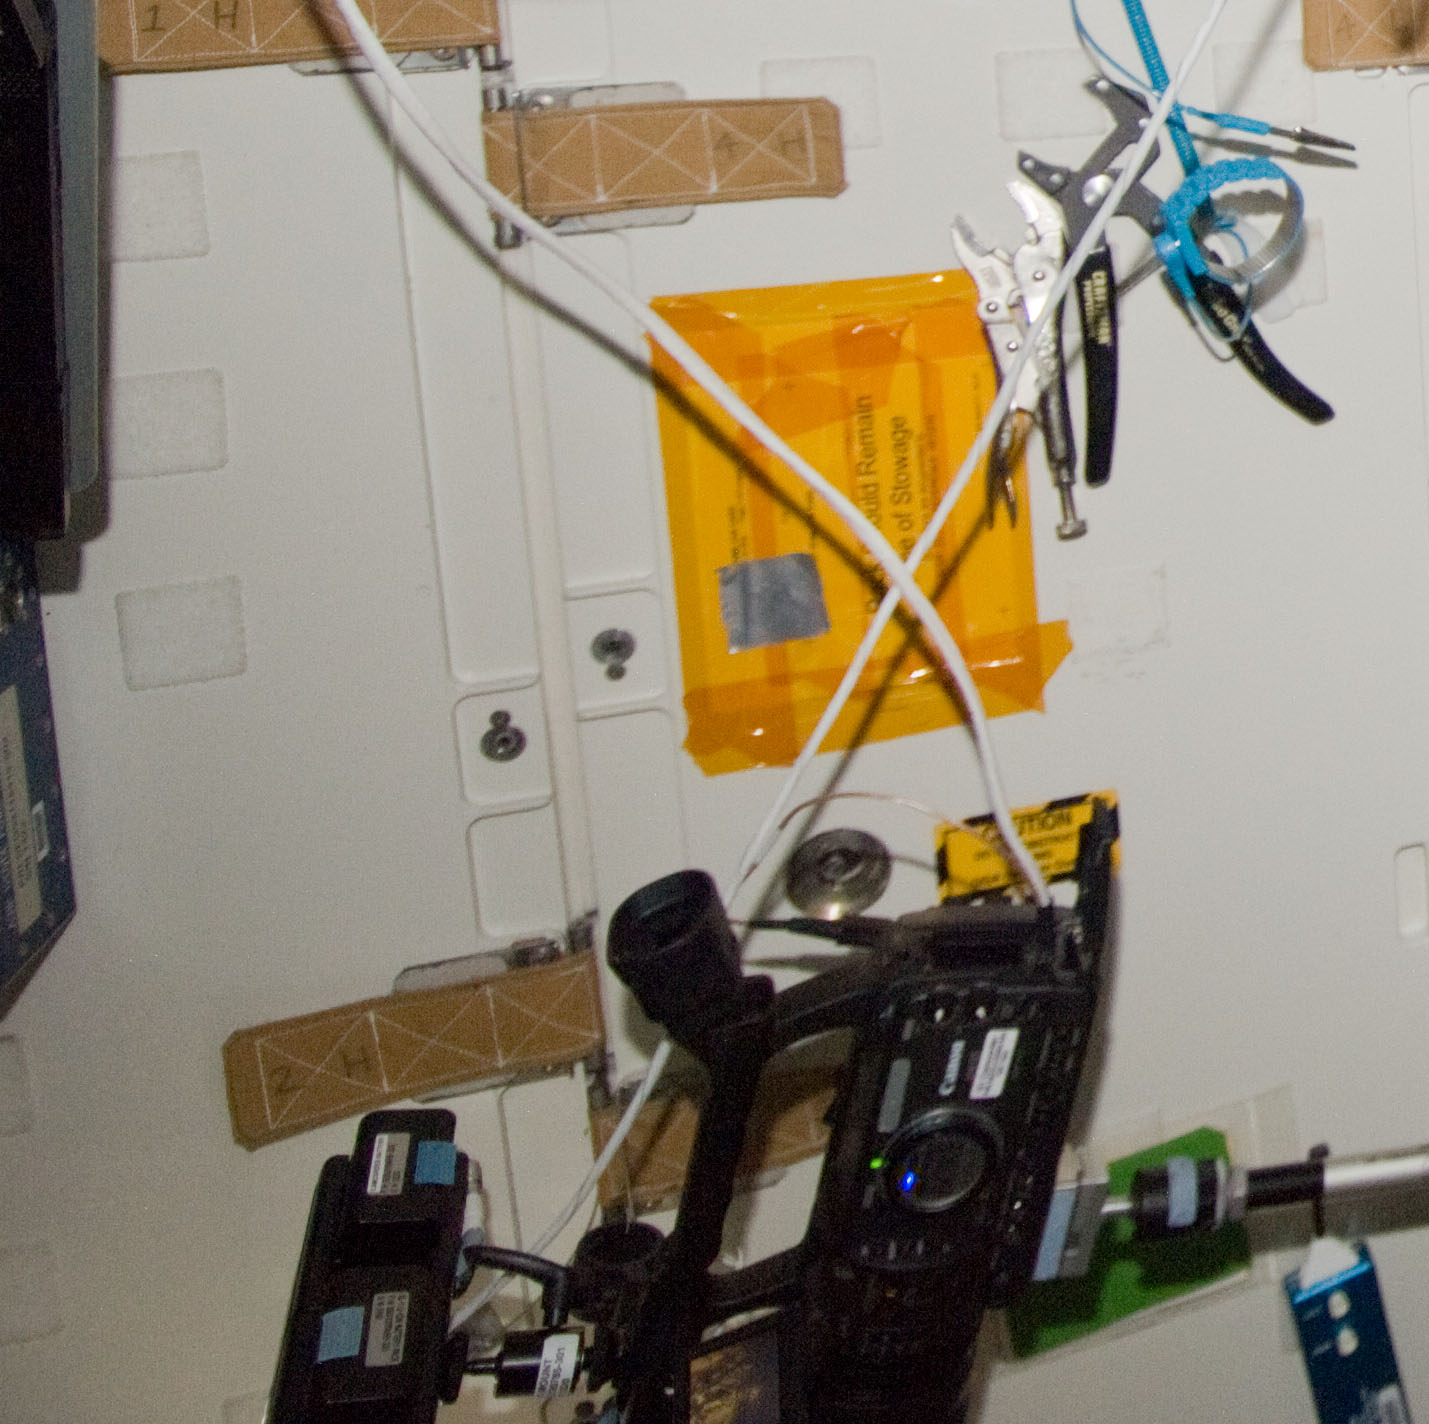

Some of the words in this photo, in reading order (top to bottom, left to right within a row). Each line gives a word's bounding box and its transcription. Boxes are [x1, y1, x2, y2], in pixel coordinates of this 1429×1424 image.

[214, 0, 239, 29] H
[856, 395, 877, 477] Remain
[890, 415, 914, 506] Stowage
[892, 511, 914, 532] of
